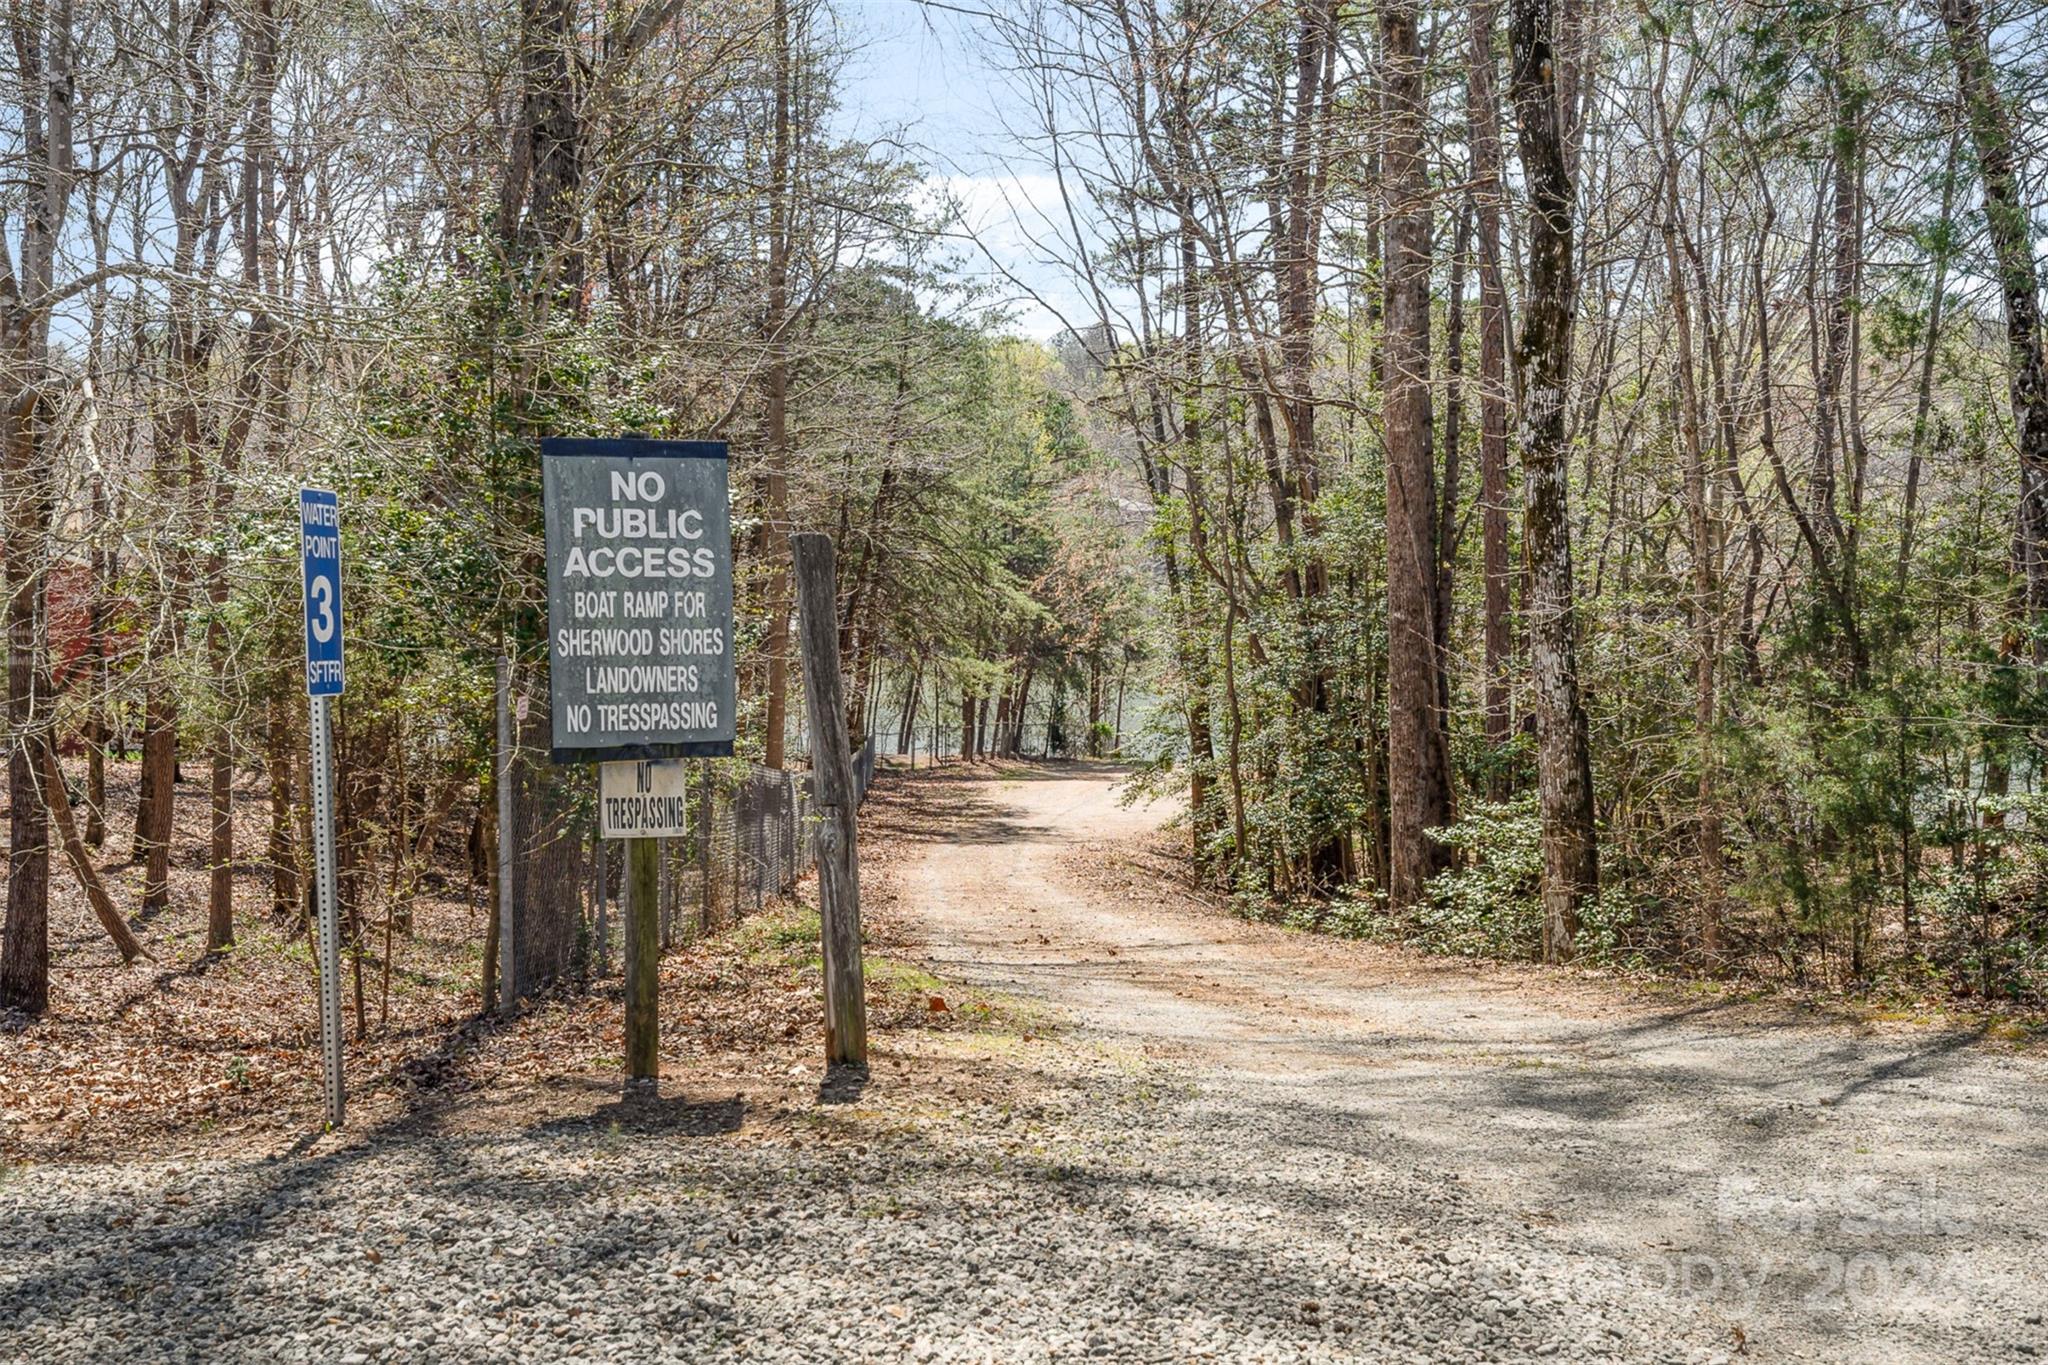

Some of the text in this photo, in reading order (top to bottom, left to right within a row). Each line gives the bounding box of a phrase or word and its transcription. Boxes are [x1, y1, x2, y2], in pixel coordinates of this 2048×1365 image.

[610, 471, 665, 502] NO
[302, 502, 337, 528] WATER
[573, 507, 703, 540] PUBLIC
[305, 537, 337, 559] POINT
[563, 547, 715, 578] ACCESS
[311, 574, 335, 643] 3
[575, 591, 706, 618] BOAT RAMP FOR
[557, 627, 724, 657] SHERWOOD SHORES
[309, 660, 342, 684] SFTFR
[586, 665, 698, 694] LANDOWNERS
[567, 701, 718, 733] NO TRESSPASSING
[636, 761, 652, 793] NO
[605, 796, 684, 829] TRESPASSING
